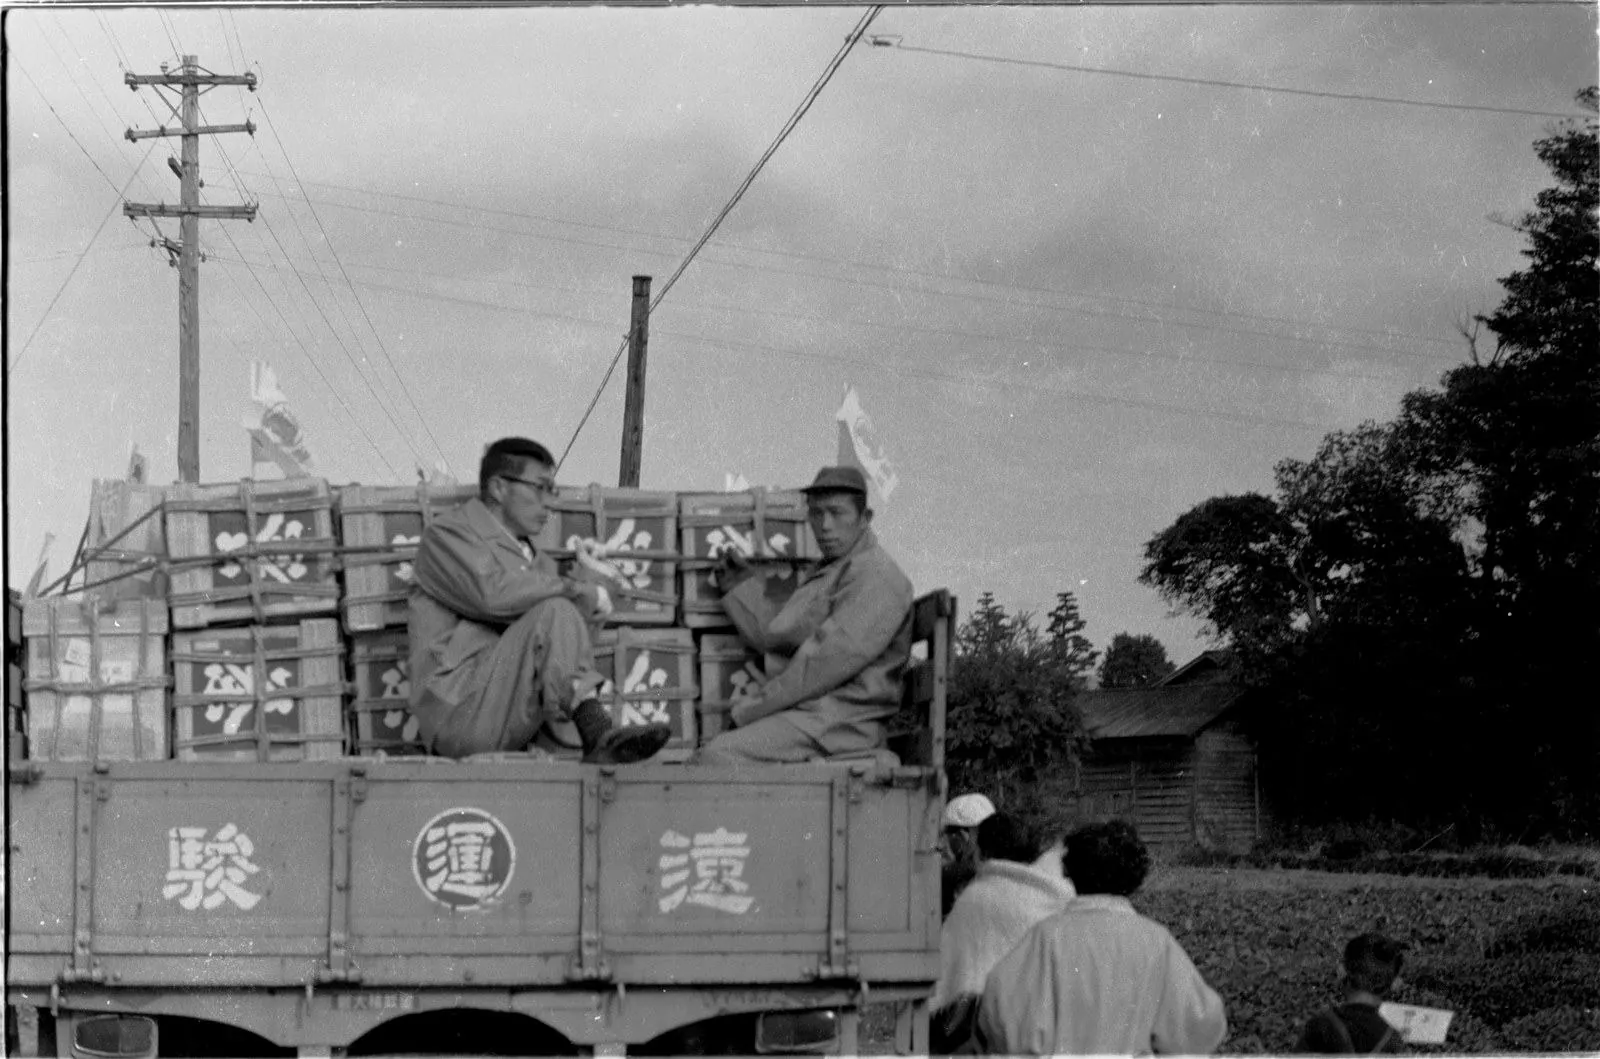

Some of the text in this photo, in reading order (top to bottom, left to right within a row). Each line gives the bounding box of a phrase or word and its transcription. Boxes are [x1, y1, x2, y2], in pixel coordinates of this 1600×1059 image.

[162, 821, 755, 915] 駿 運 遠
